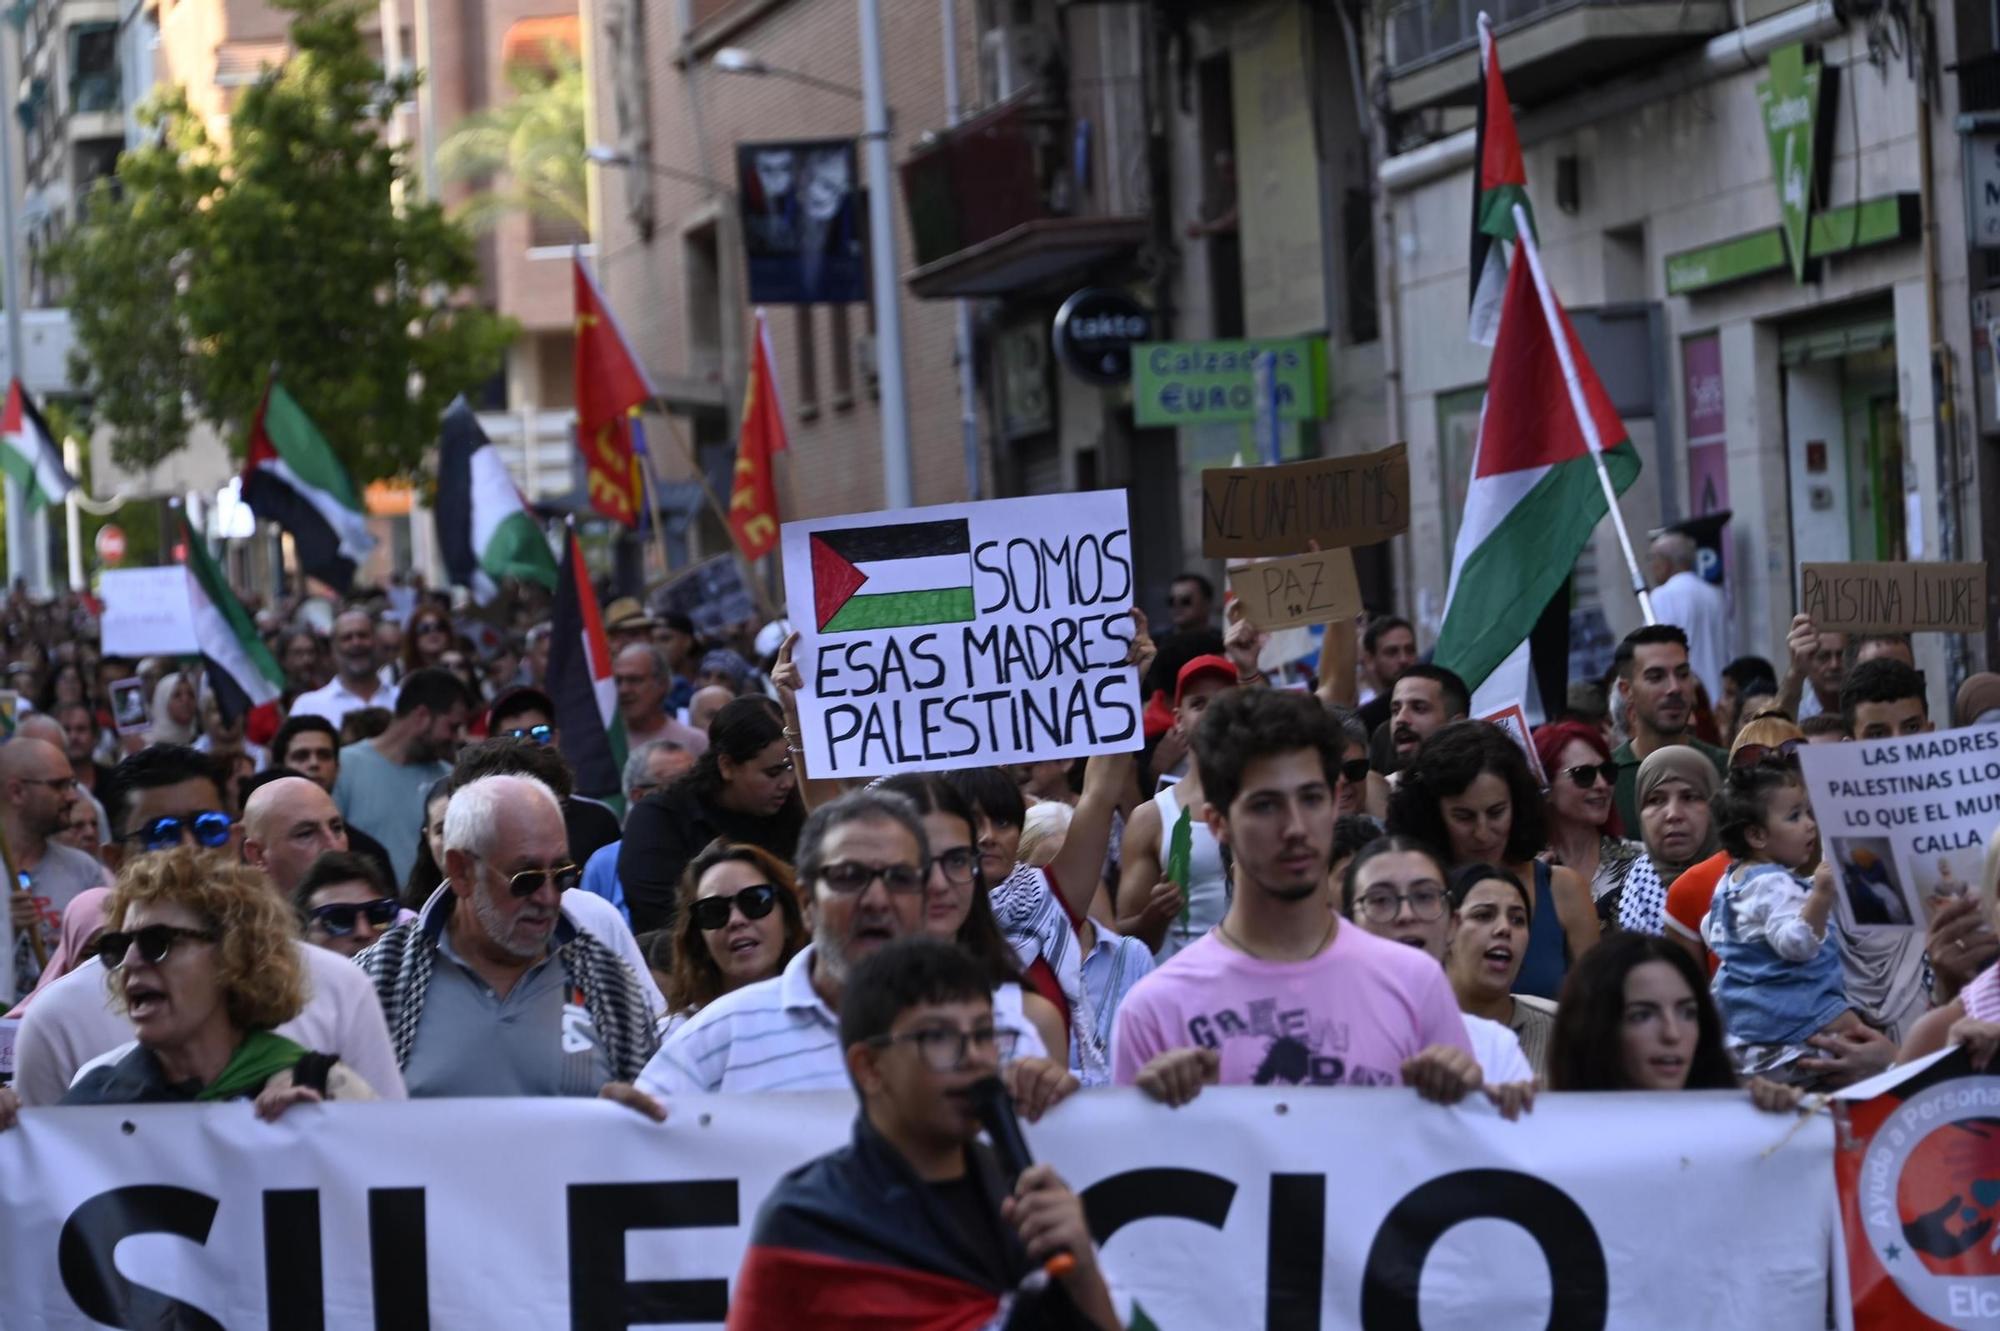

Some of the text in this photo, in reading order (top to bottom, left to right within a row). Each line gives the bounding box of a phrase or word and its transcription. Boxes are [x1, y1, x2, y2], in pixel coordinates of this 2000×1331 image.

[973, 529, 1132, 614] SOMOS
[1262, 561, 1334, 618] PAZ
[1803, 568, 1903, 624] PALESTINA
[815, 612, 1134, 699] ESAS MADRES
[824, 674, 1137, 771] PALESTINAS
[1861, 731, 1999, 766] LAS MADRES
[1828, 770, 1953, 797] PALESTINAS
[1844, 809, 1870, 827] LO
[1875, 806, 1919, 830] QUE
[1925, 803, 1949, 822] EL
[1912, 829, 1983, 854] CALLA
[1870, 1146, 1894, 1228] Ayuda
[1892, 1128, 1905, 1146] a
